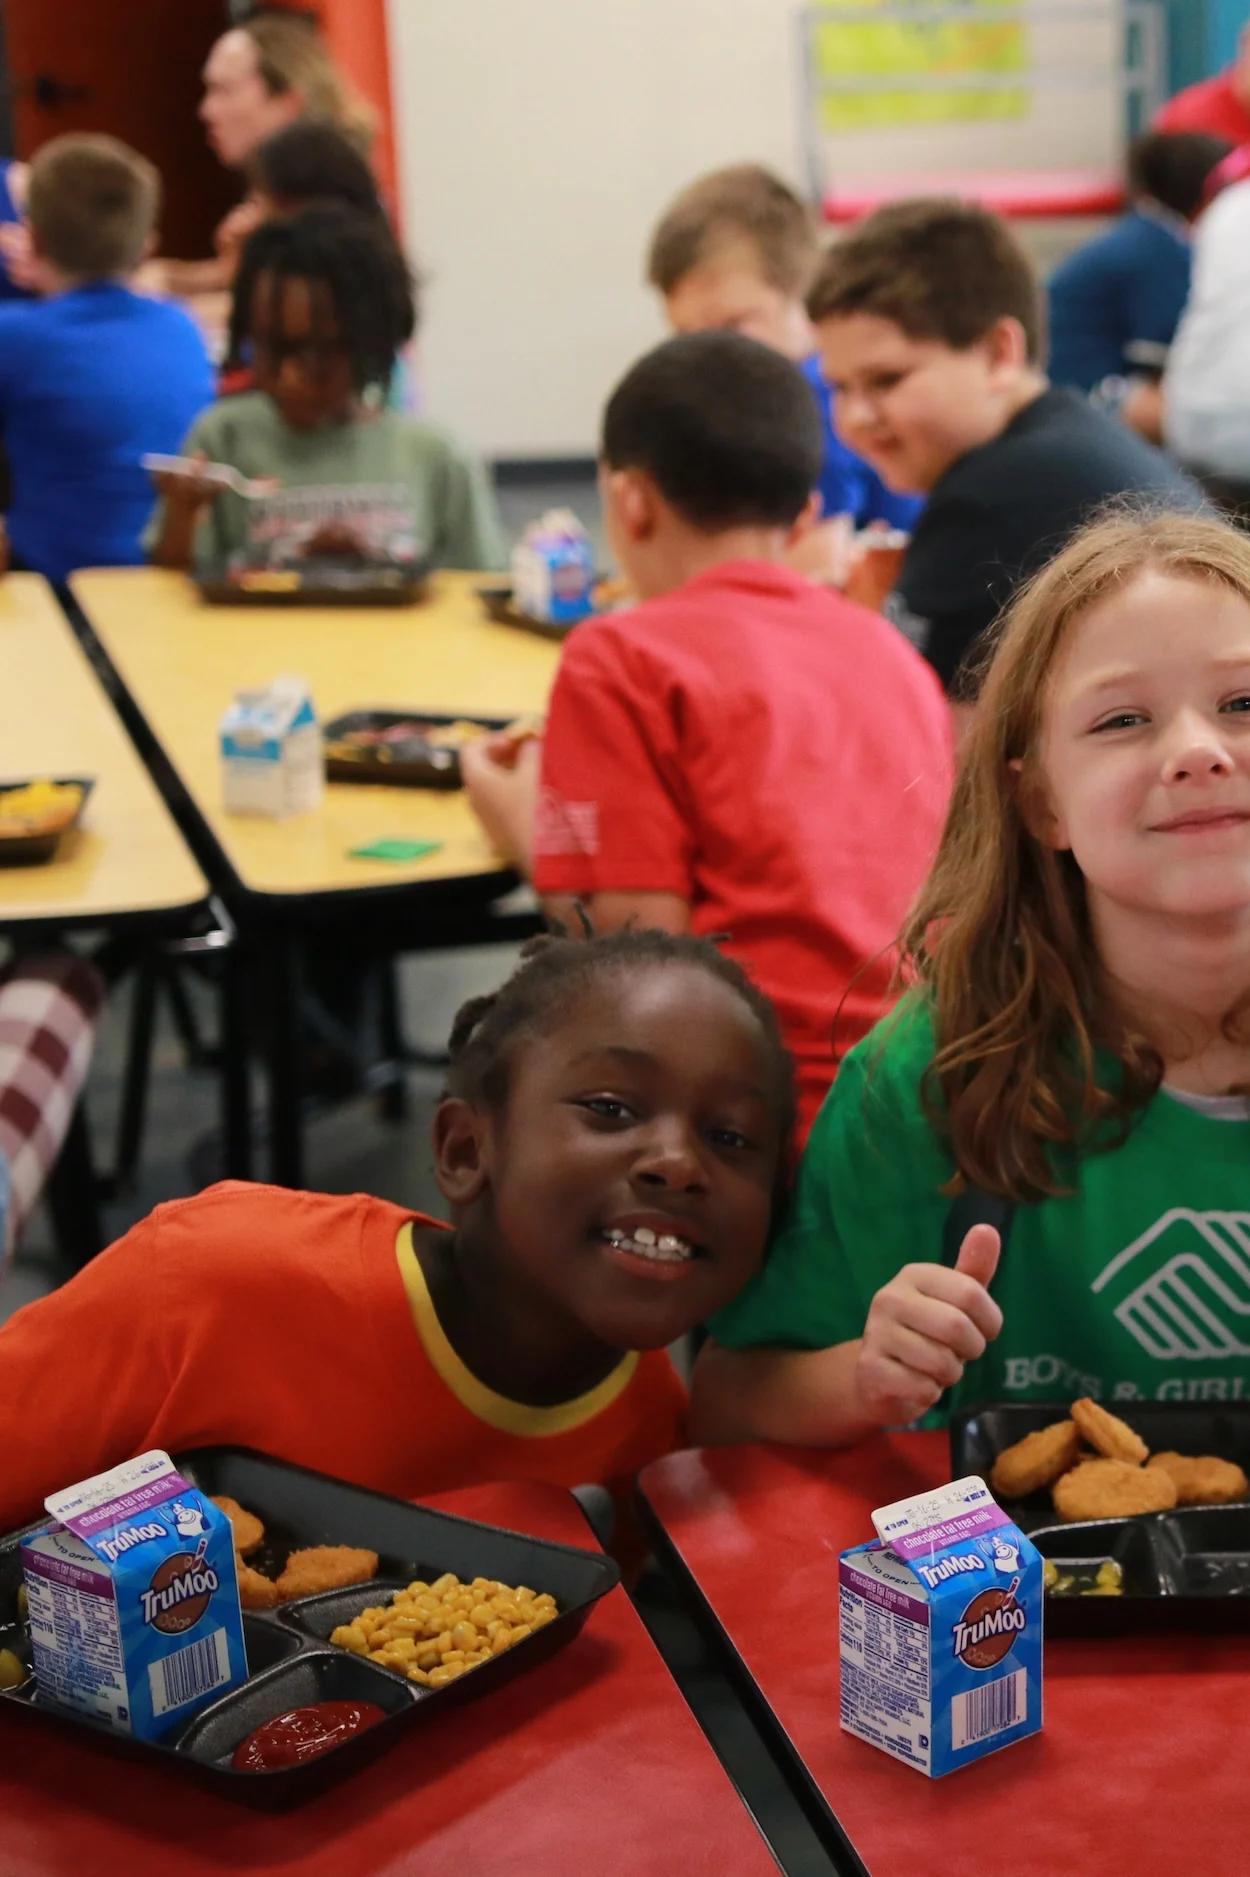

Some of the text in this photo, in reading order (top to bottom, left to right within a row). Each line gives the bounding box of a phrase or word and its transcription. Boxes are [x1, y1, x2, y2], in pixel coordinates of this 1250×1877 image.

[1004, 1355, 1100, 1399] BOYS
[79, 1502, 121, 1527] chocolate
[121, 1497, 134, 1511] fat
[134, 1489, 154, 1505] free
[155, 1480, 173, 1495] milk
[897, 1519, 908, 1528] OPEN
[903, 1510, 993, 1549] chocolate fat free milk
[58, 1545, 94, 1562] TO OPEN
[96, 1523, 166, 1561] TruMoo
[61, 1562, 69, 1575] fat
[70, 1565, 81, 1579] free
[872, 1565, 909, 1585] TO OPEN
[917, 1554, 985, 1588] TruMoo
[141, 1570, 218, 1623] TruMoo
[840, 1586, 862, 1607] Nutrition
[841, 1599, 853, 1613] Facts
[850, 1570, 910, 1609] chocolate fat free milk
[953, 1607, 1025, 1656] TruMoo
